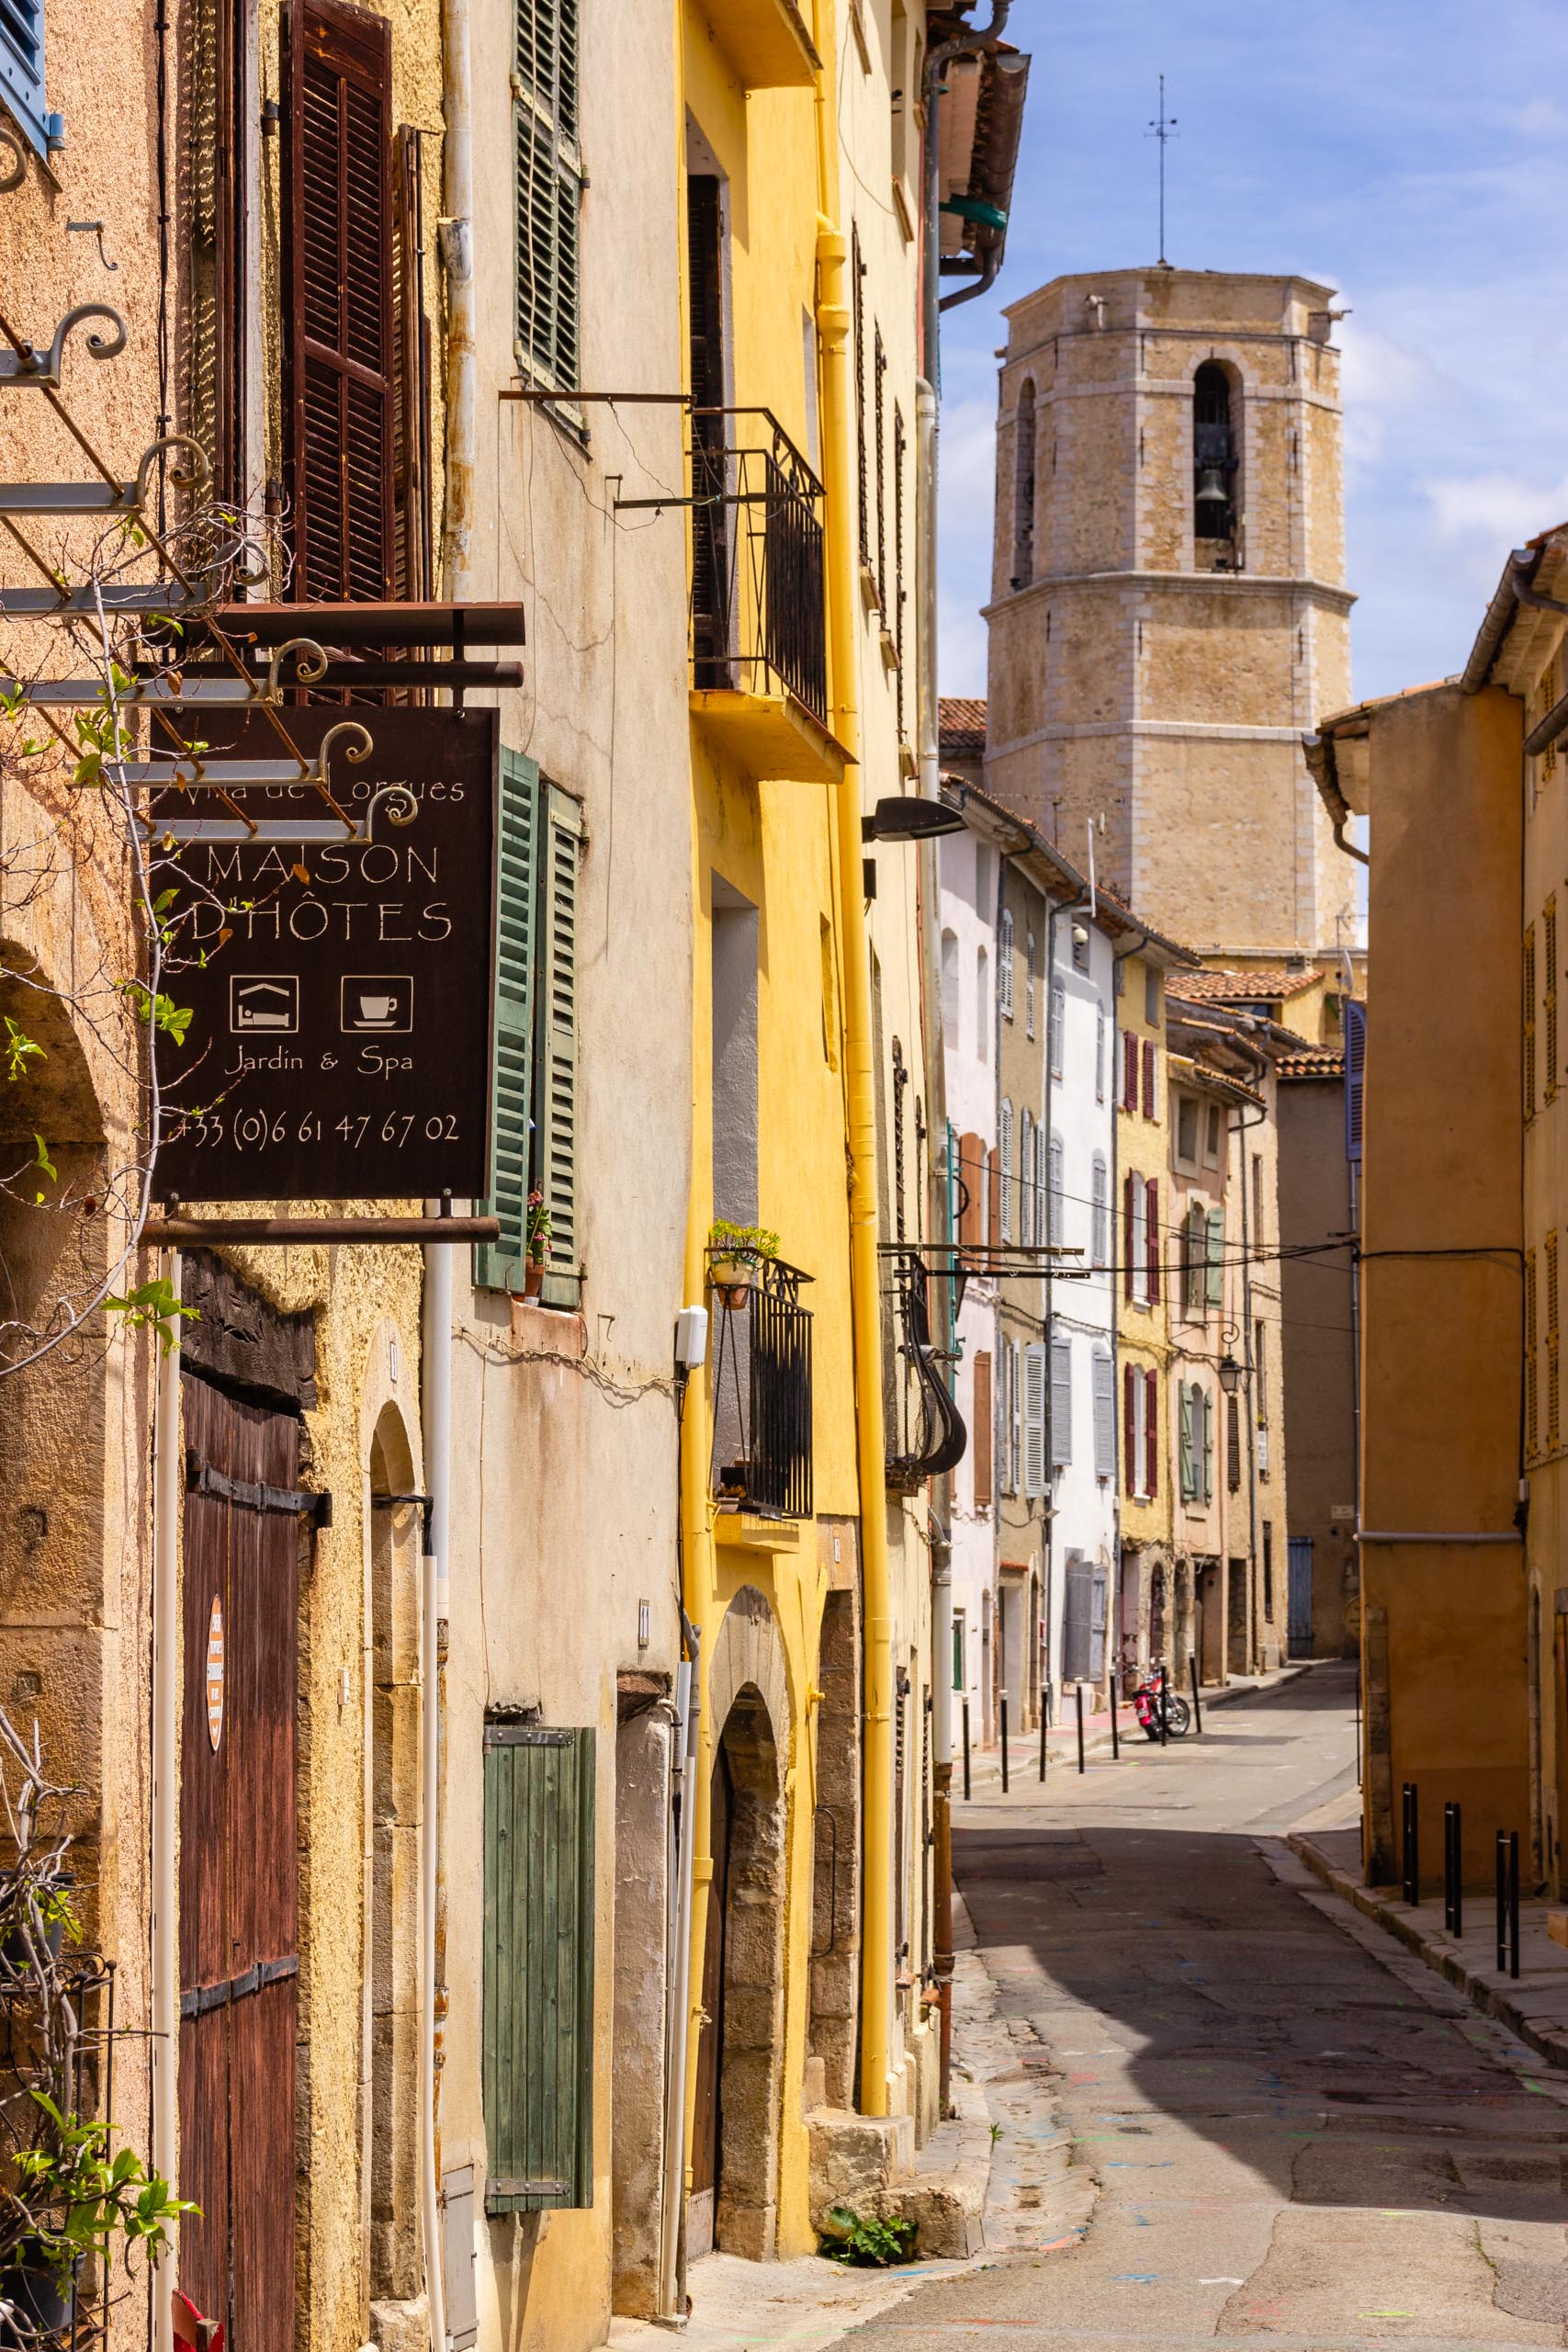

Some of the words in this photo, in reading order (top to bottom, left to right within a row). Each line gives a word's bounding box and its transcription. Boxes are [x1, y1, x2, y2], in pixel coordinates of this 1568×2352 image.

[326, 762, 465, 814] Lorgues
[208, 845, 437, 883] MAISON
[192, 891, 452, 941] D'HÔTES
[224, 1045, 303, 1075] Jardin
[321, 1052, 338, 1069] &
[357, 1046, 413, 1080] Spa
[177, 1114, 223, 1148] +33
[233, 1108, 287, 1151] (0)6
[299, 1111, 321, 1142] 61
[335, 1115, 371, 1148] 47
[382, 1111, 415, 1148] 67
[425, 1114, 459, 1140] 02
